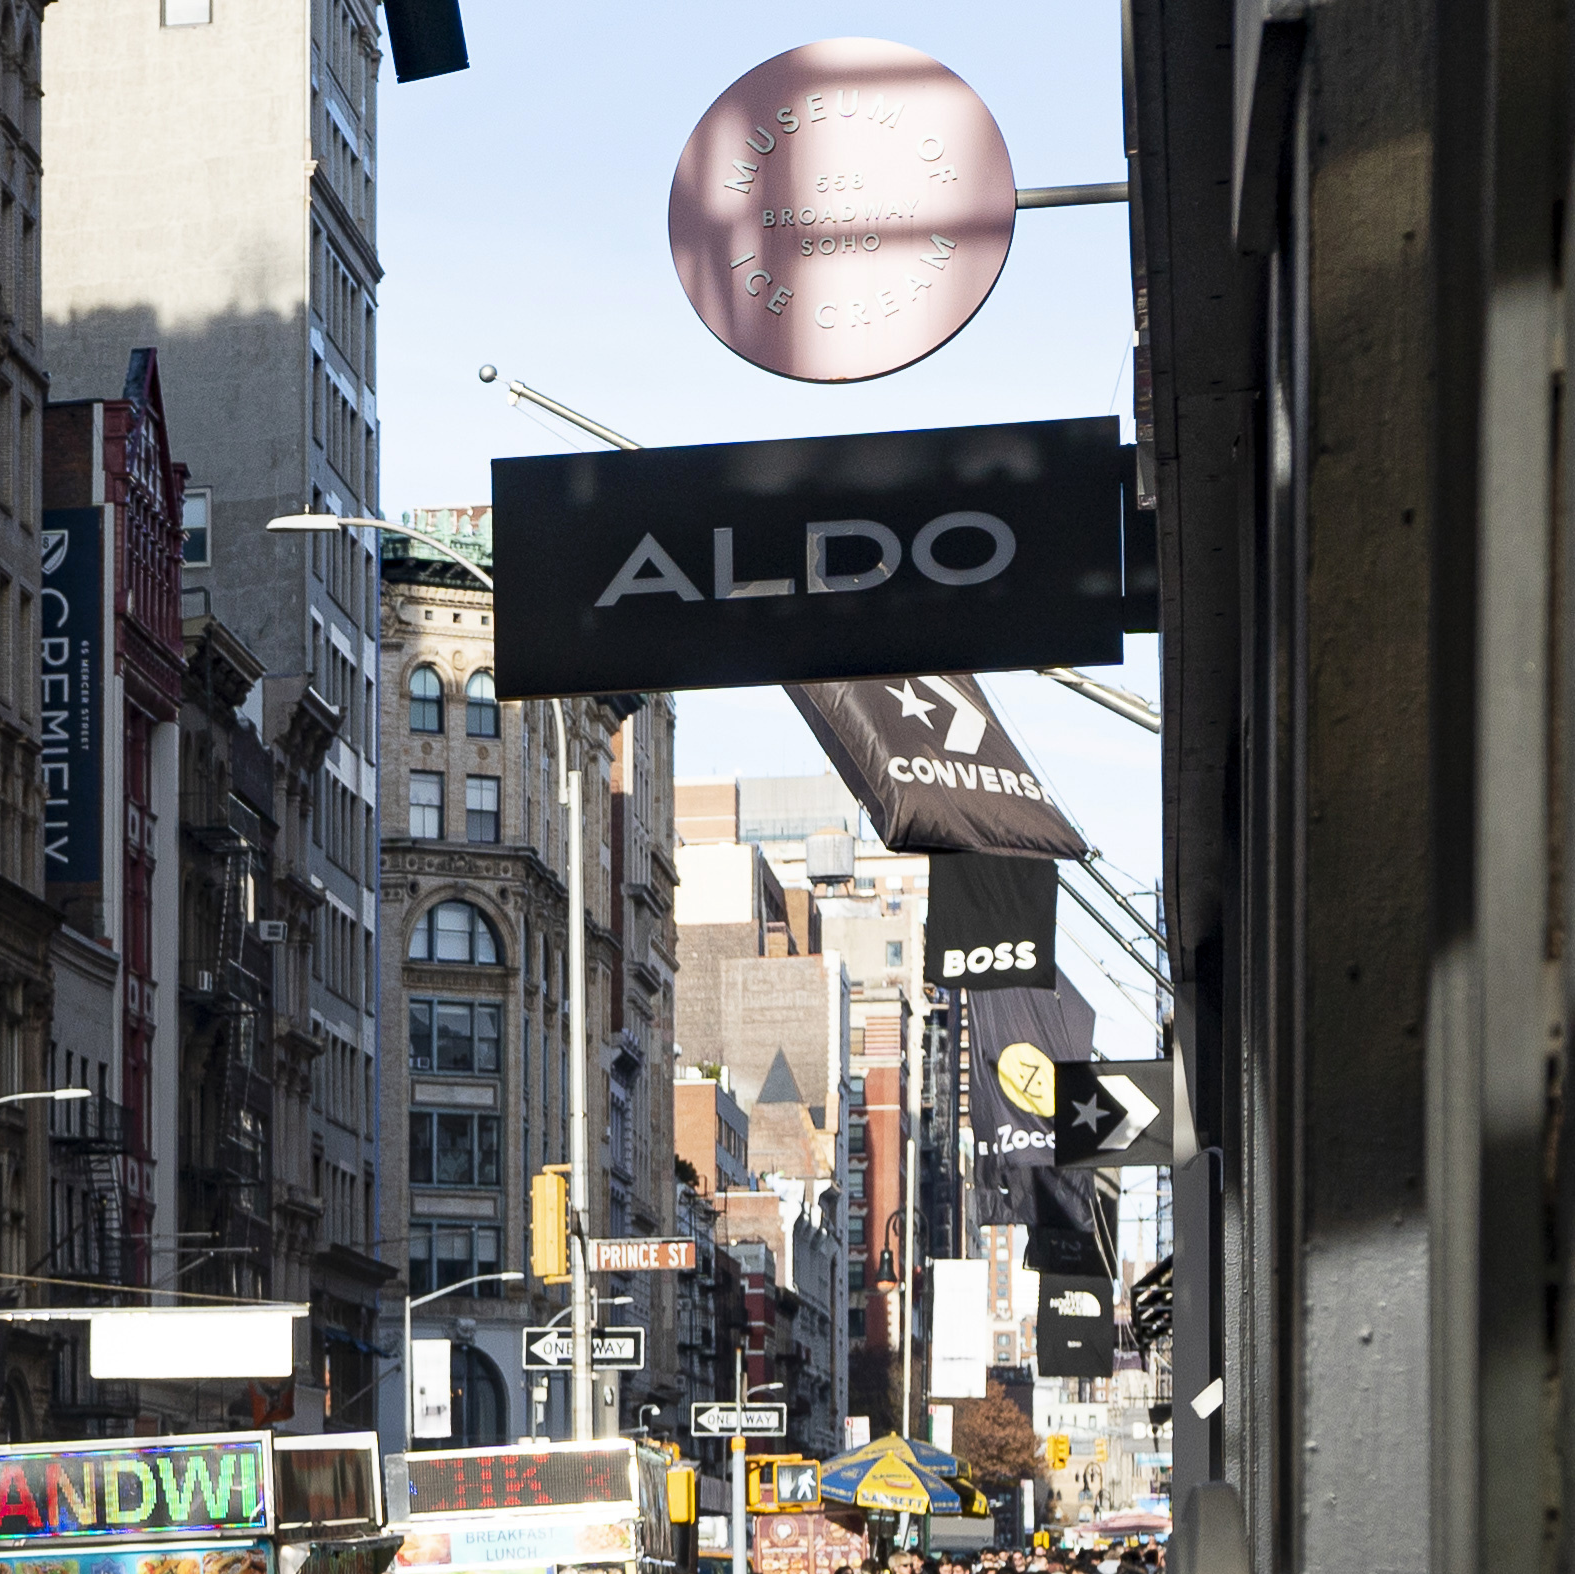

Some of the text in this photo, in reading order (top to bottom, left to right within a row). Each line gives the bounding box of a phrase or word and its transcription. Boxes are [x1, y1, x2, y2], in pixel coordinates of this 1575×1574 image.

[723, 89, 958, 194] MUSEUM OF
[815, 172, 864, 192] 558
[762, 199, 920, 228] BROADWAY
[800, 232, 881, 257] SOHO
[729, 233, 958, 329] ICE CREAM
[593, 510, 1018, 607] ALDO
[80, 658, 90, 704] MERCER
[80, 708, 90, 751] STREET
[942, 940, 1037, 978] BOSS
[600, 1242, 689, 1268] PRINCE ST
[543, 1338, 627, 1356] ONE WAY
[707, 1413, 773, 1425] ONE WAY
[466, 1526, 555, 1545] BREAKFAST
[486, 1546, 538, 1562] LUNCH
